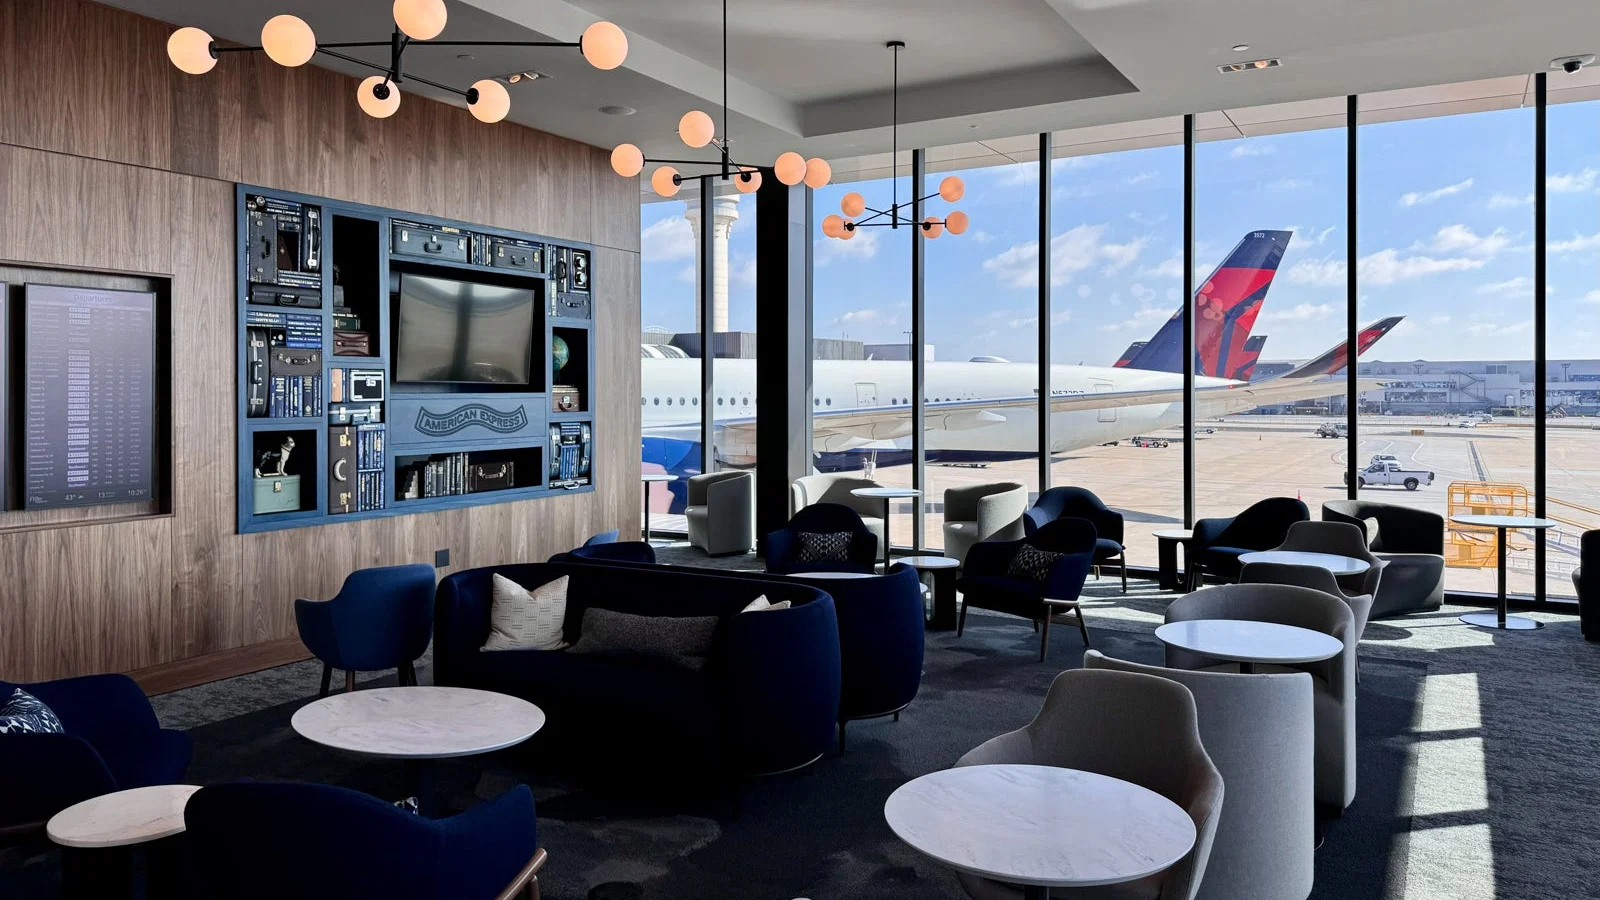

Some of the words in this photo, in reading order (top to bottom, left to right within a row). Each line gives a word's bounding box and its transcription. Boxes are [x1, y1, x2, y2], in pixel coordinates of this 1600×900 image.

[73, 293, 112, 304] Departures
[424, 409, 477, 430] AMERICAN
[479, 410, 520, 428] EXPRESS
